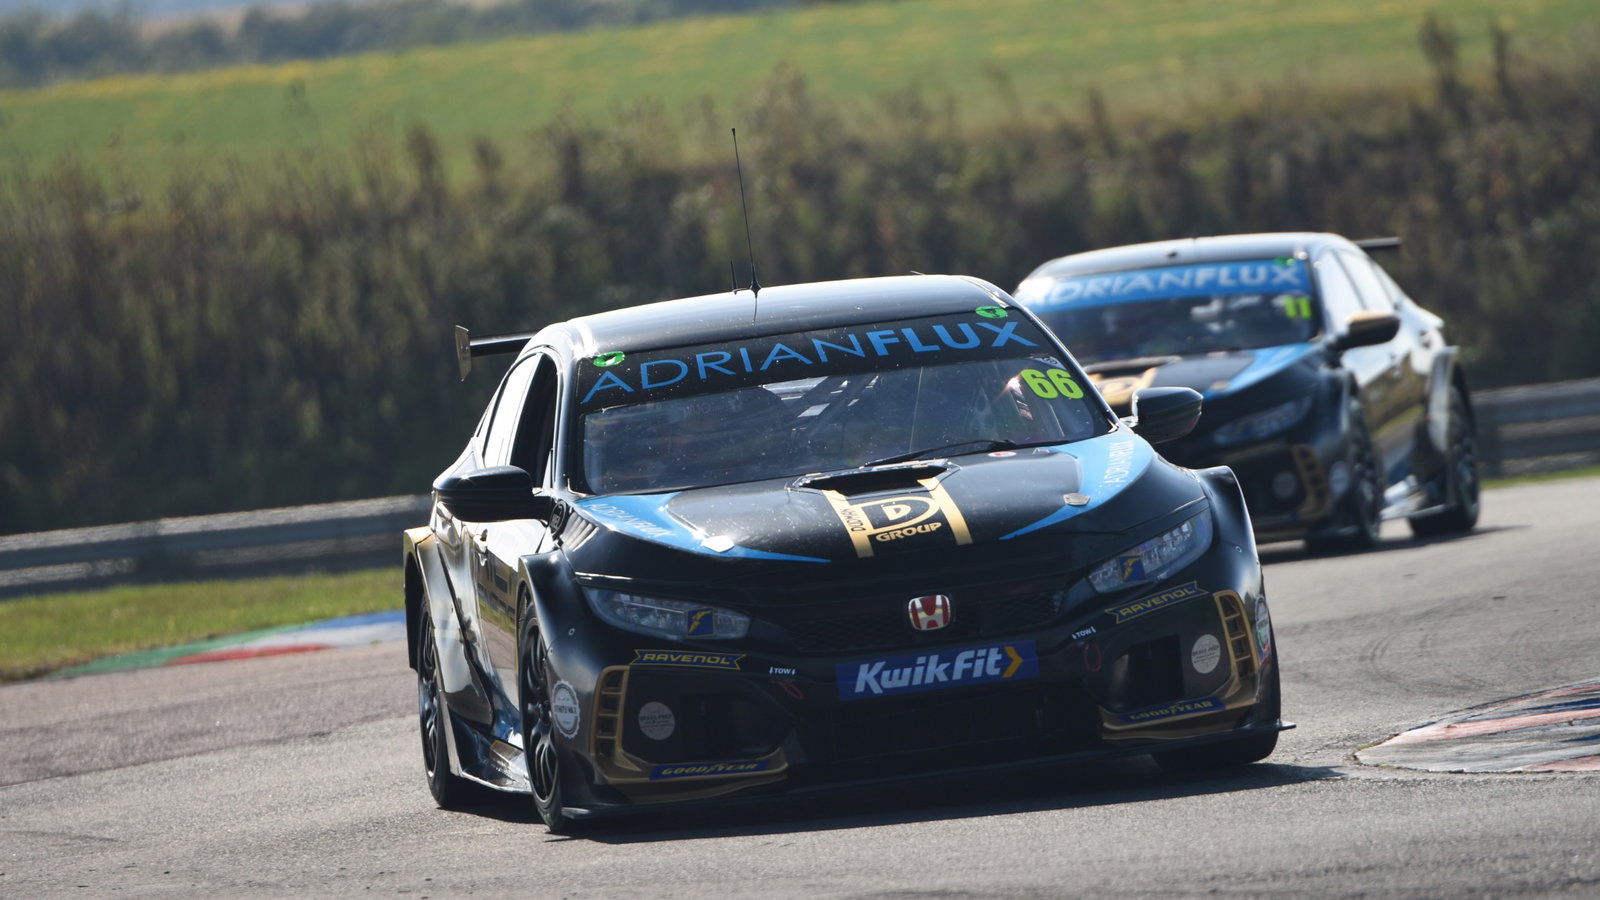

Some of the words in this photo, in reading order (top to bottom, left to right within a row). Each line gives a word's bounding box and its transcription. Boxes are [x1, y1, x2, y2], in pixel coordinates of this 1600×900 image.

[1024, 263, 1300, 305] DRIANFLUX
[1285, 296, 1312, 320] 11
[582, 320, 1038, 403] ADRIANFLUX
[1021, 367, 1084, 400] 66
[876, 521, 942, 542] GROUP
[1120, 587, 1196, 616] RAVENOL
[1076, 627, 1092, 638] TOW
[642, 652, 731, 665] RAVENOL
[1129, 700, 1213, 720] GOODYEAR
[661, 763, 758, 776] GOODYEAR
